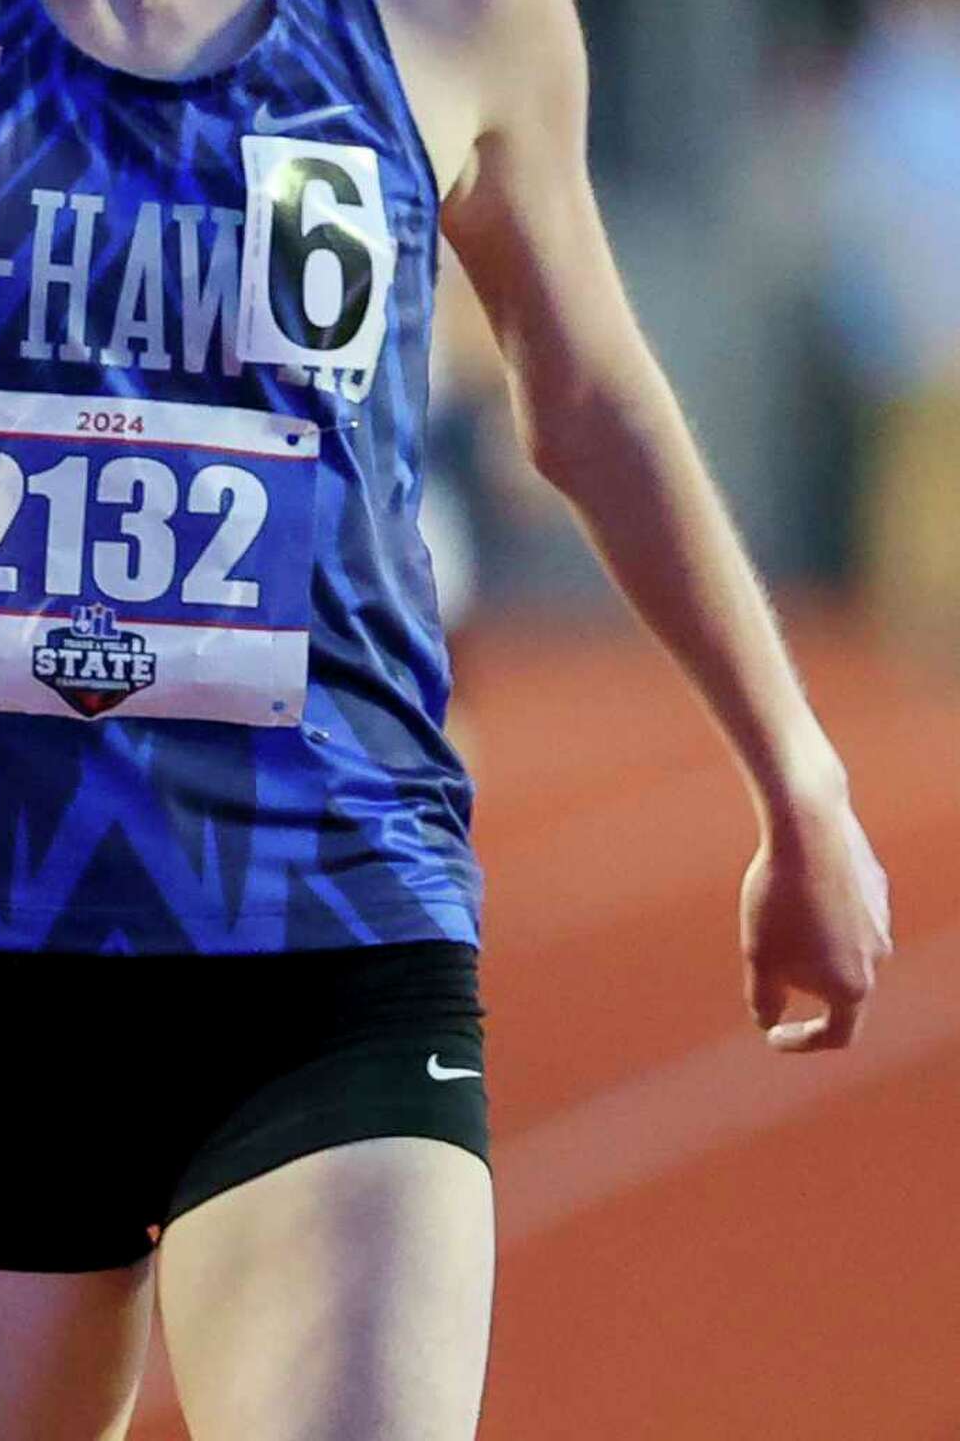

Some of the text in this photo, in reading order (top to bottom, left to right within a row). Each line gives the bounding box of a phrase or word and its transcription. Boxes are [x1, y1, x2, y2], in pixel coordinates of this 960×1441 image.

[268, 157, 372, 351] 6
[76, 411, 144, 434] 2024
[34, 647, 154, 682] STATE
